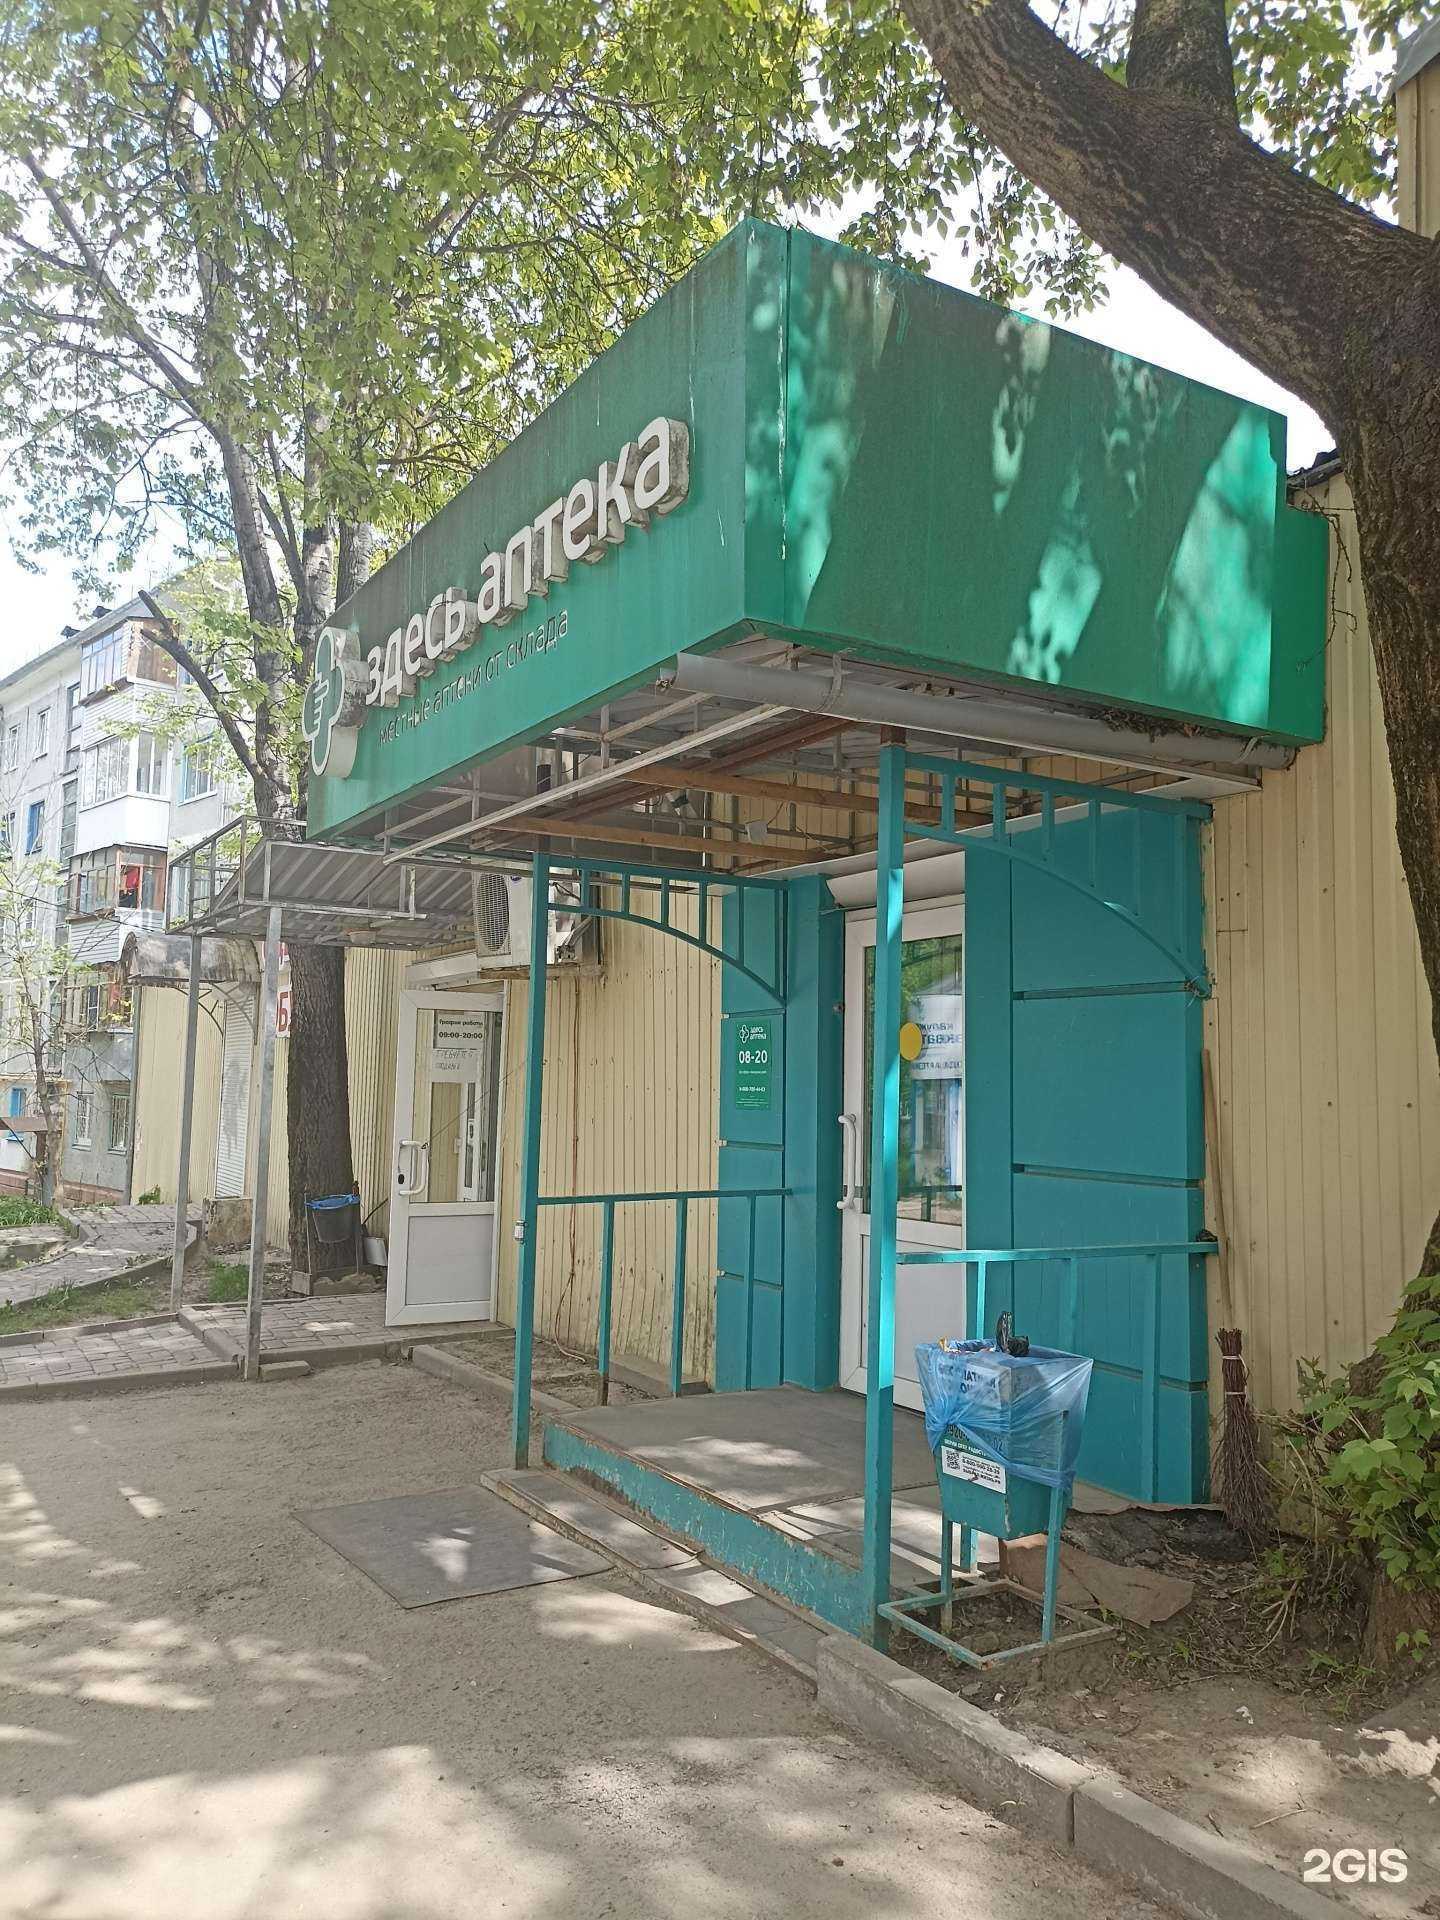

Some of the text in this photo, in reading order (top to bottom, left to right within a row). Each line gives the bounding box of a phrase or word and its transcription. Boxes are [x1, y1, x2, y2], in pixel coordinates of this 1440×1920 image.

[365, 416, 687, 706] здесь аптека
[378, 608, 569, 746] местные аптеки от склада
[439, 1031, 483, 1039] 09:00-20:00
[738, 1050, 768, 1064] 08-20
